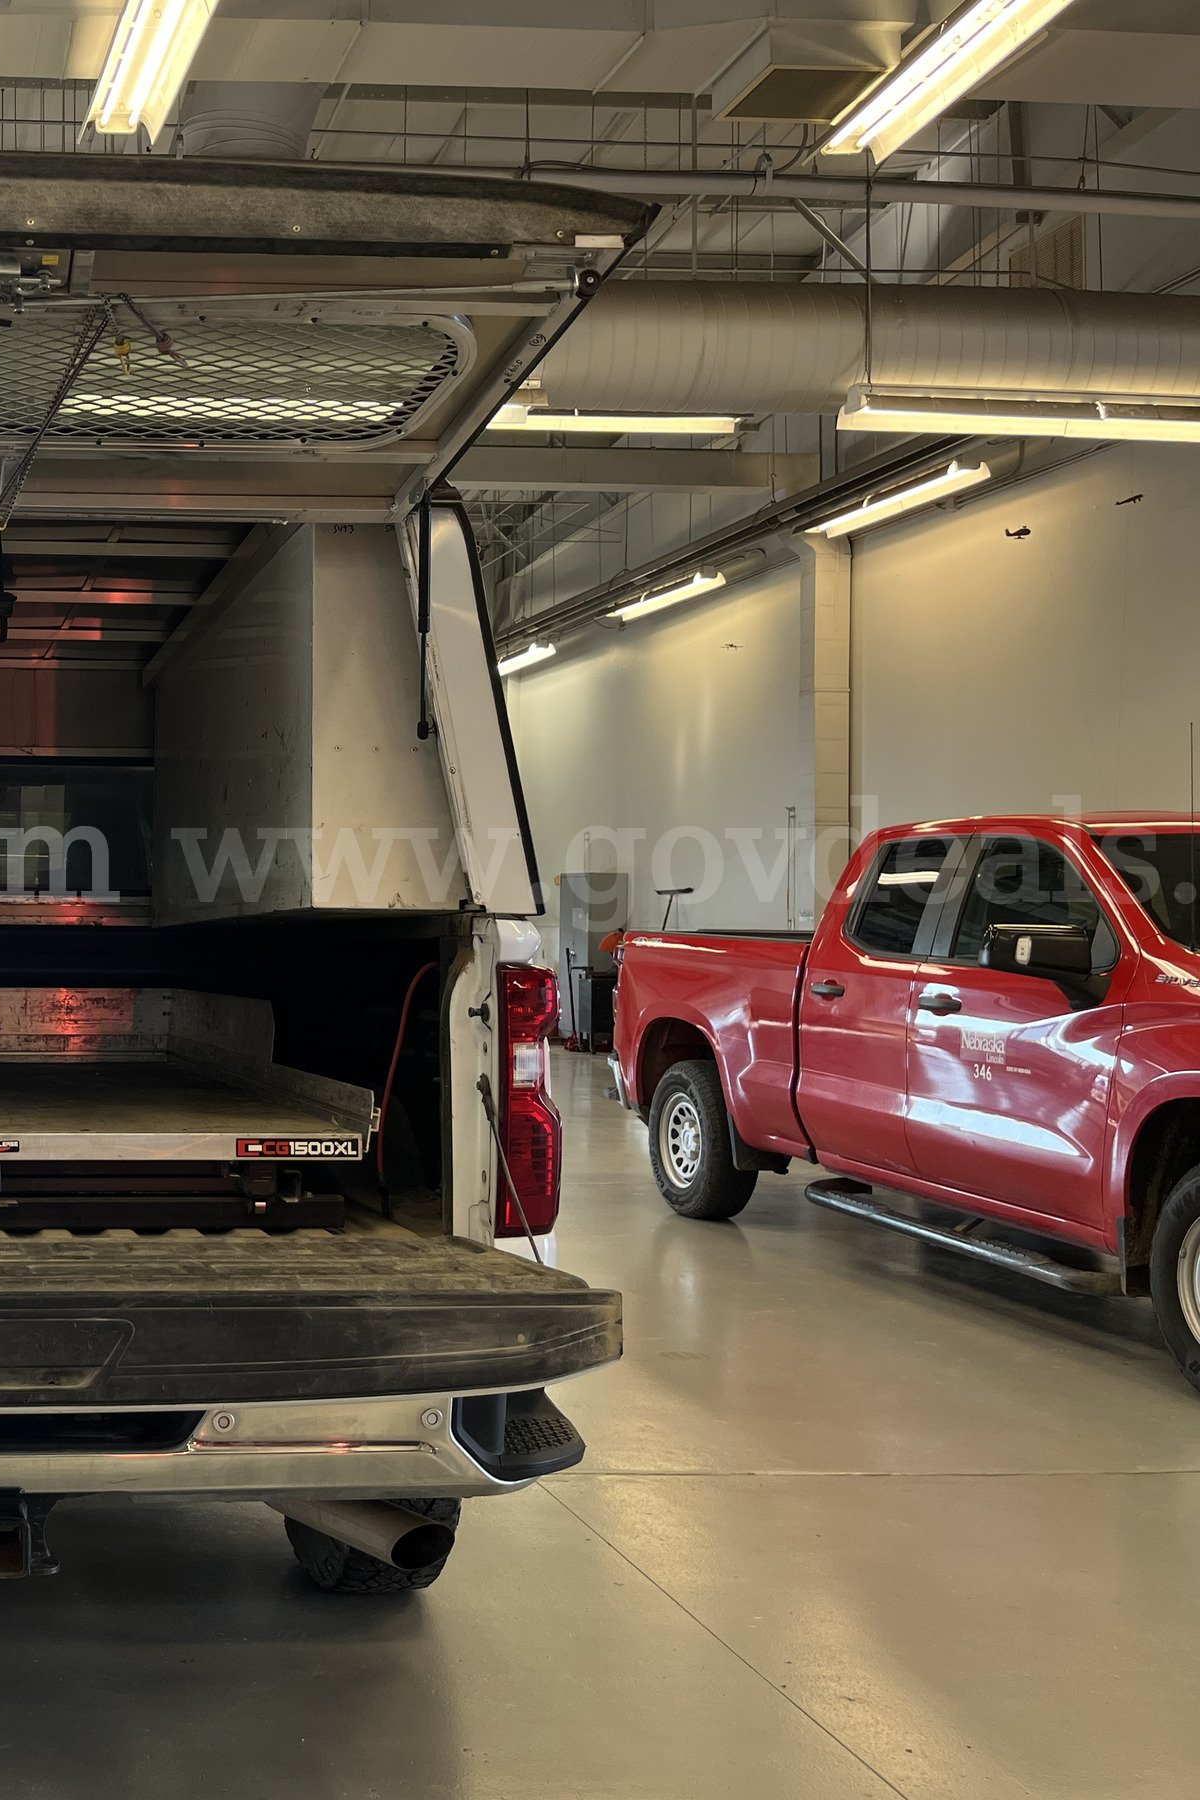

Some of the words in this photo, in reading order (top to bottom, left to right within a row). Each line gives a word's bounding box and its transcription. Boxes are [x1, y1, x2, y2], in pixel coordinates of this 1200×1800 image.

[332, 524, 355, 534] 5493
[961, 1030, 1006, 1054] Nebraska
[973, 1063, 992, 1081] 346
[262, 1141, 357, 1155] CG1500XL
